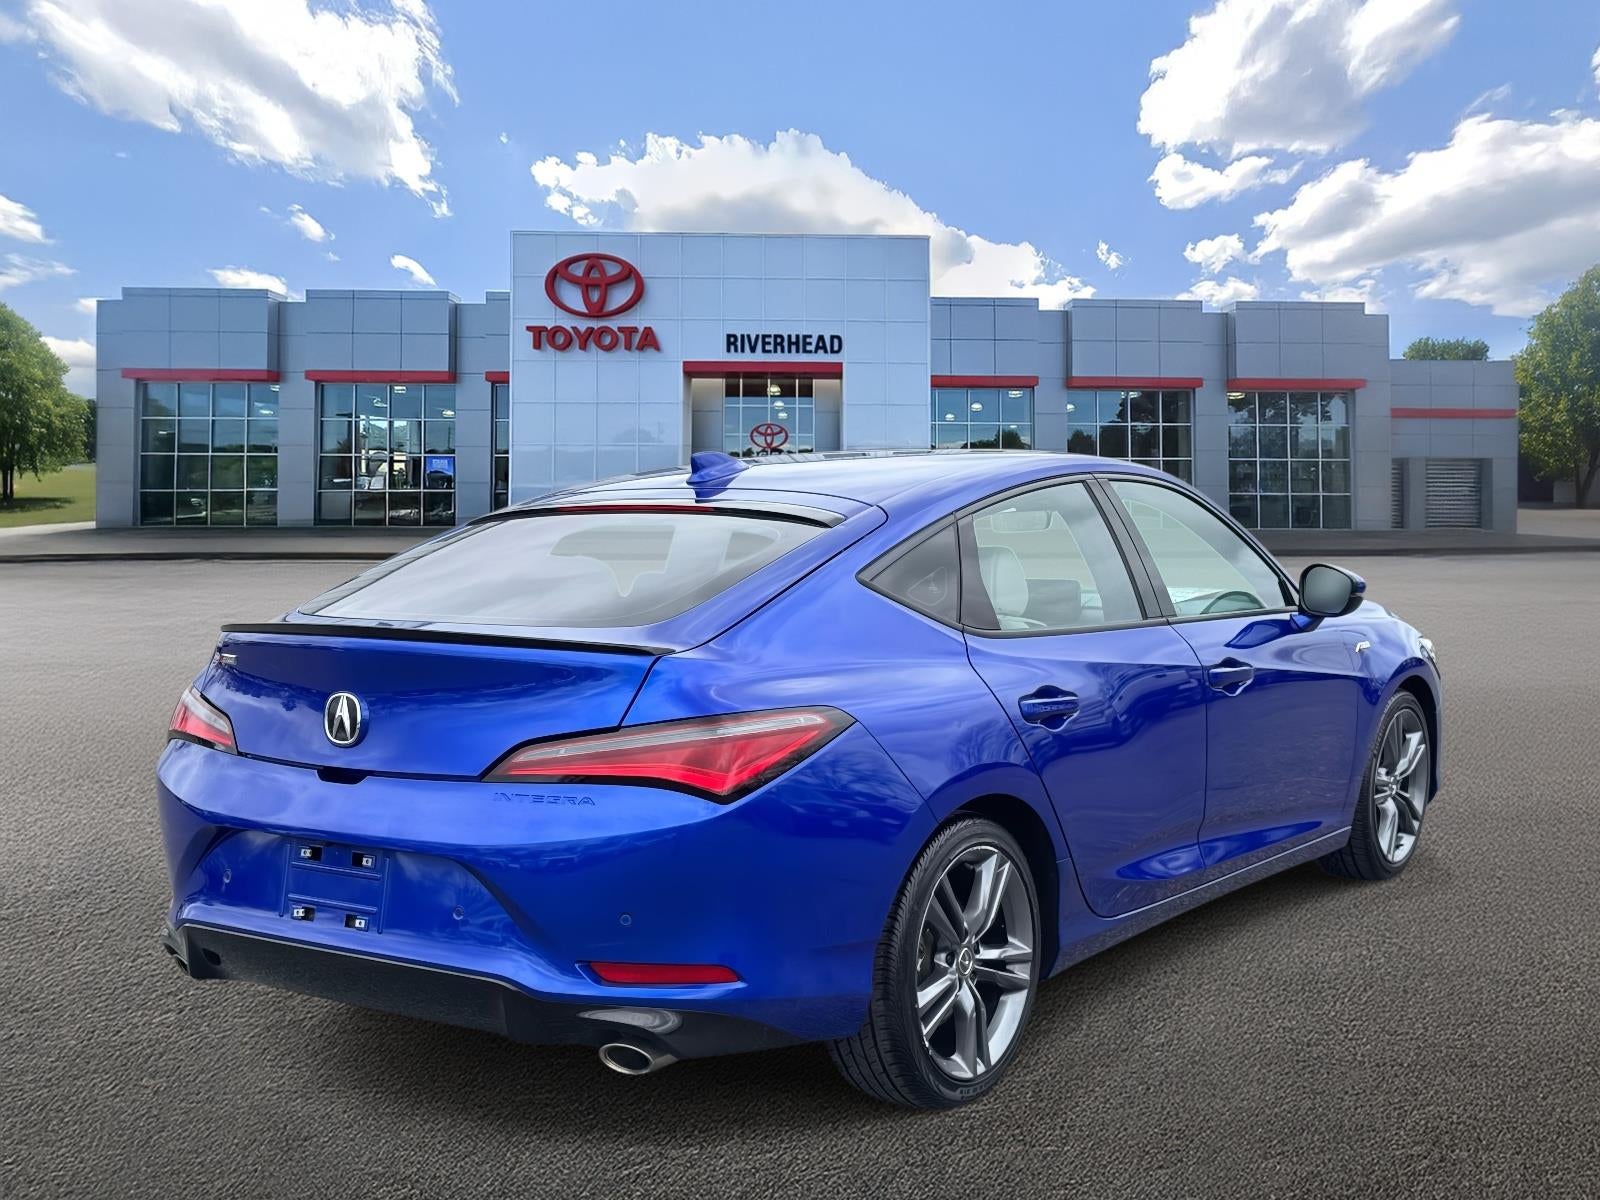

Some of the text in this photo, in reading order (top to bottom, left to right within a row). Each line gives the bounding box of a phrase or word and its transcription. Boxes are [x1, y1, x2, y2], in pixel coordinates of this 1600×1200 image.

[526, 325, 661, 352] TOYOTA
[726, 333, 843, 354] RIVERHEAD
[493, 792, 596, 806] INTEGRA
